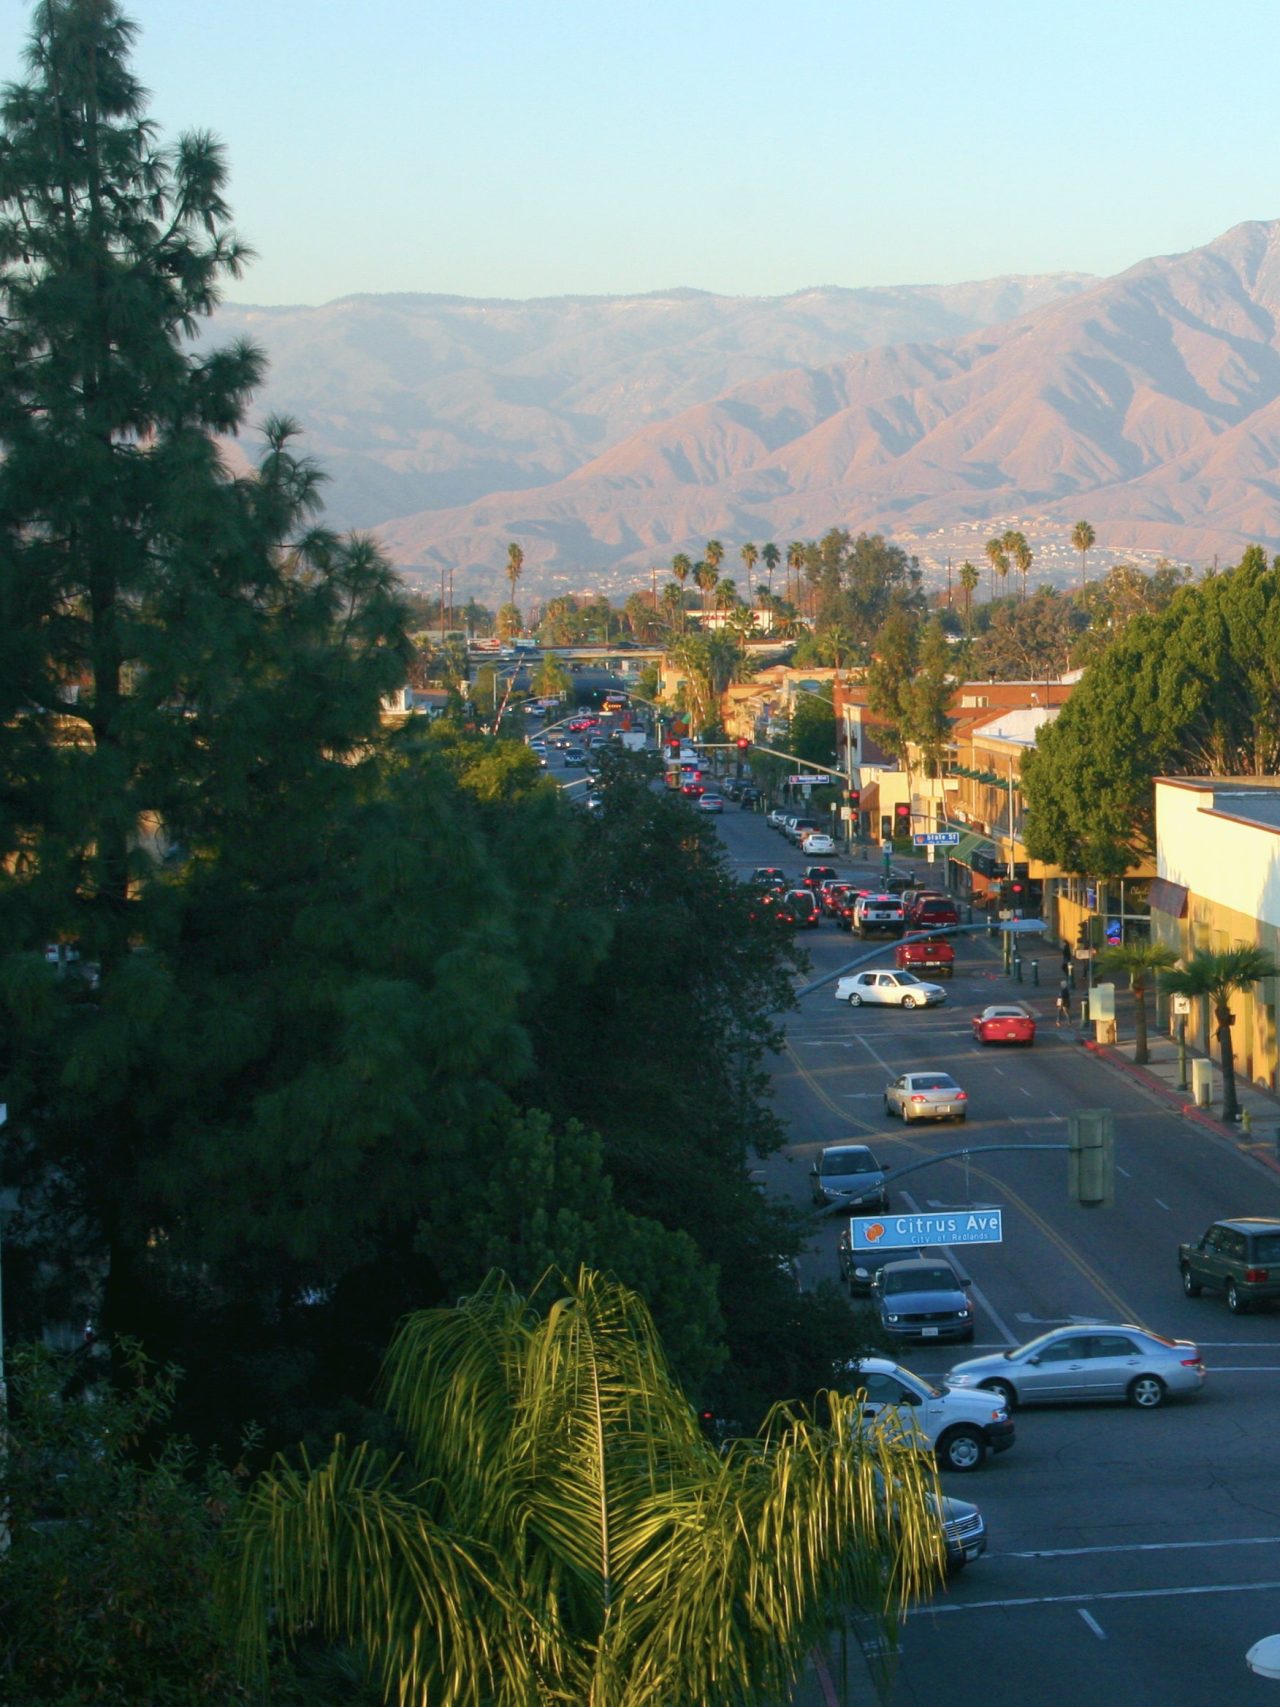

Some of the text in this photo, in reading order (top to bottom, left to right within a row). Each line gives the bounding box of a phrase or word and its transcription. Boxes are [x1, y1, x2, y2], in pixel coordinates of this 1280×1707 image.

[896, 1215, 998, 1234] Citrus Ave
[911, 1233, 988, 1243] City of Redlands
